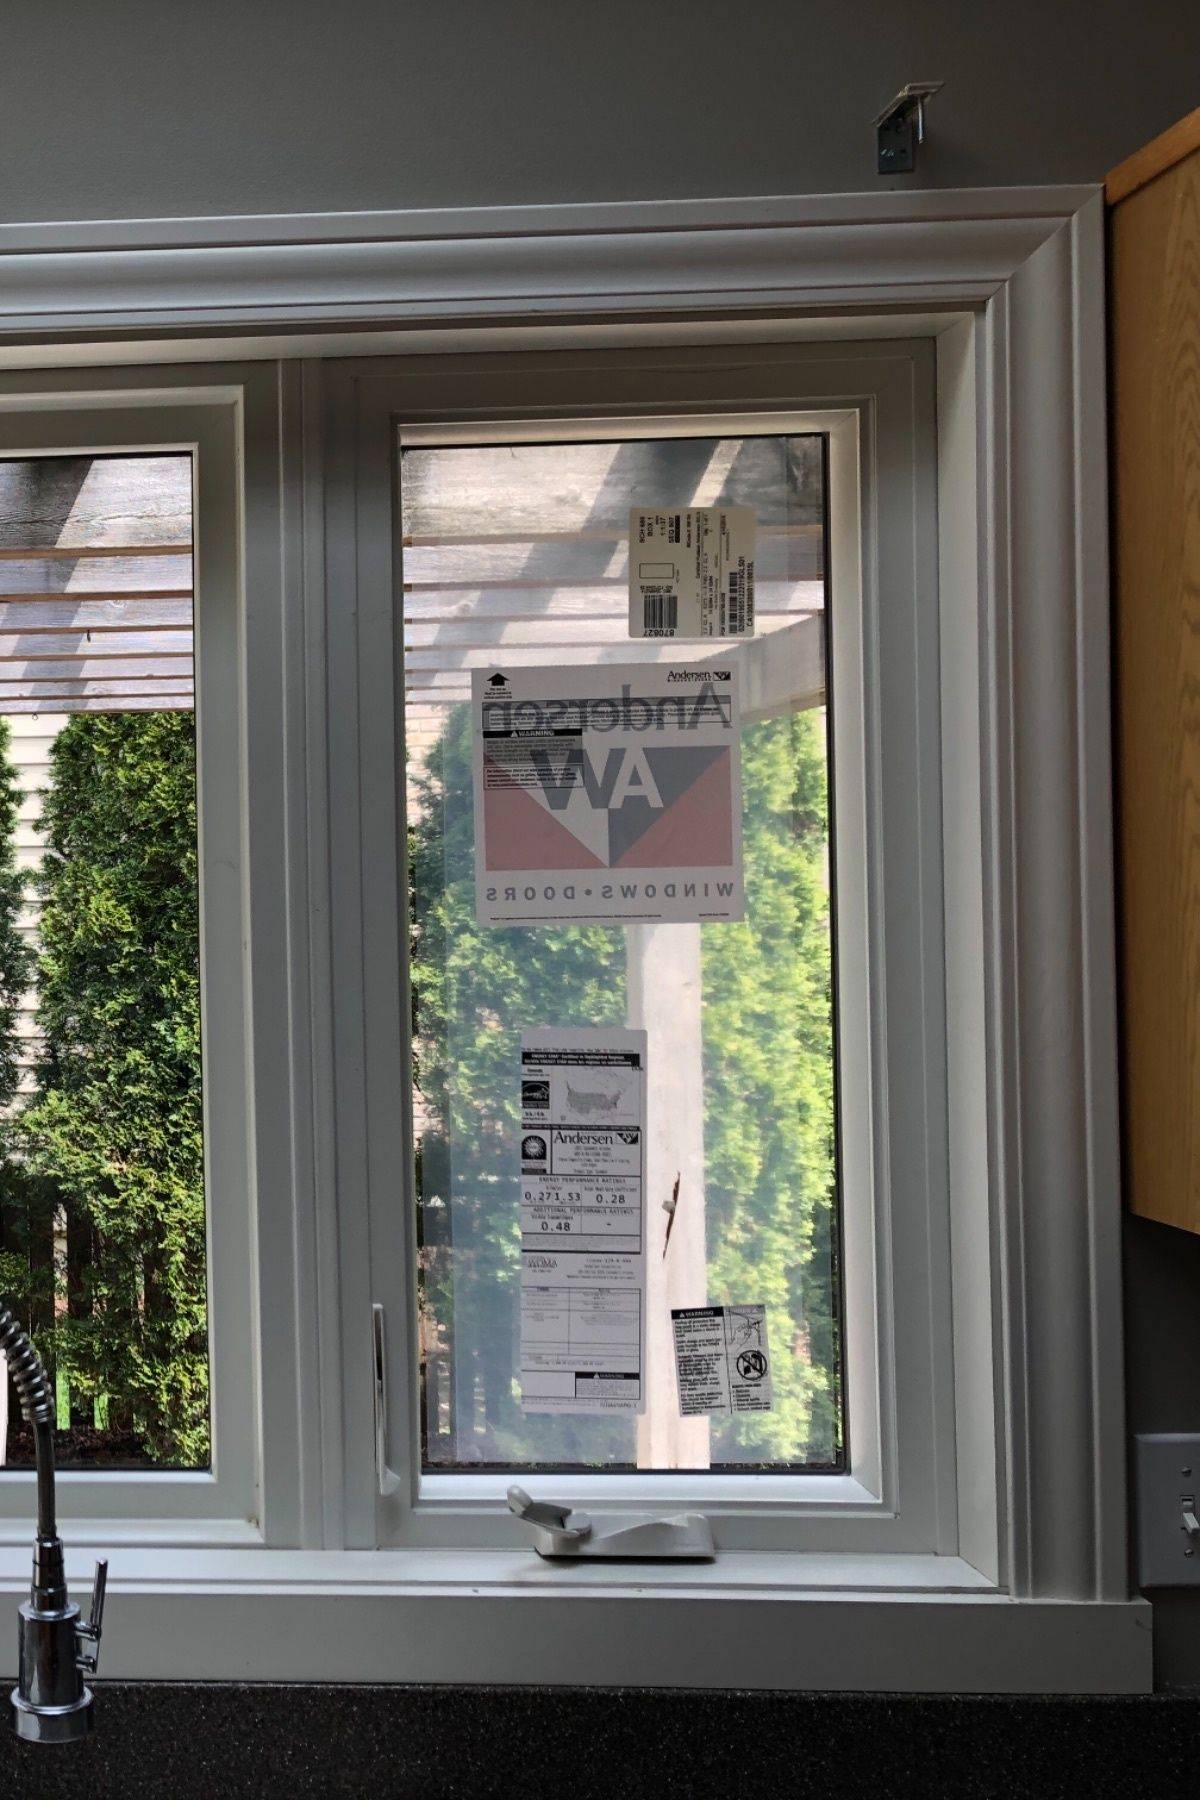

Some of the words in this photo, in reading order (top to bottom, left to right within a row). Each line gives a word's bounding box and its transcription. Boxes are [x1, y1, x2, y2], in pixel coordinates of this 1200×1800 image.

[667, 670, 711, 680] Andersen
[554, 1131, 613, 1145] Andersen
[596, 1194, 626, 1204] 0.28
[541, 1221, 571, 1232] 0.48
